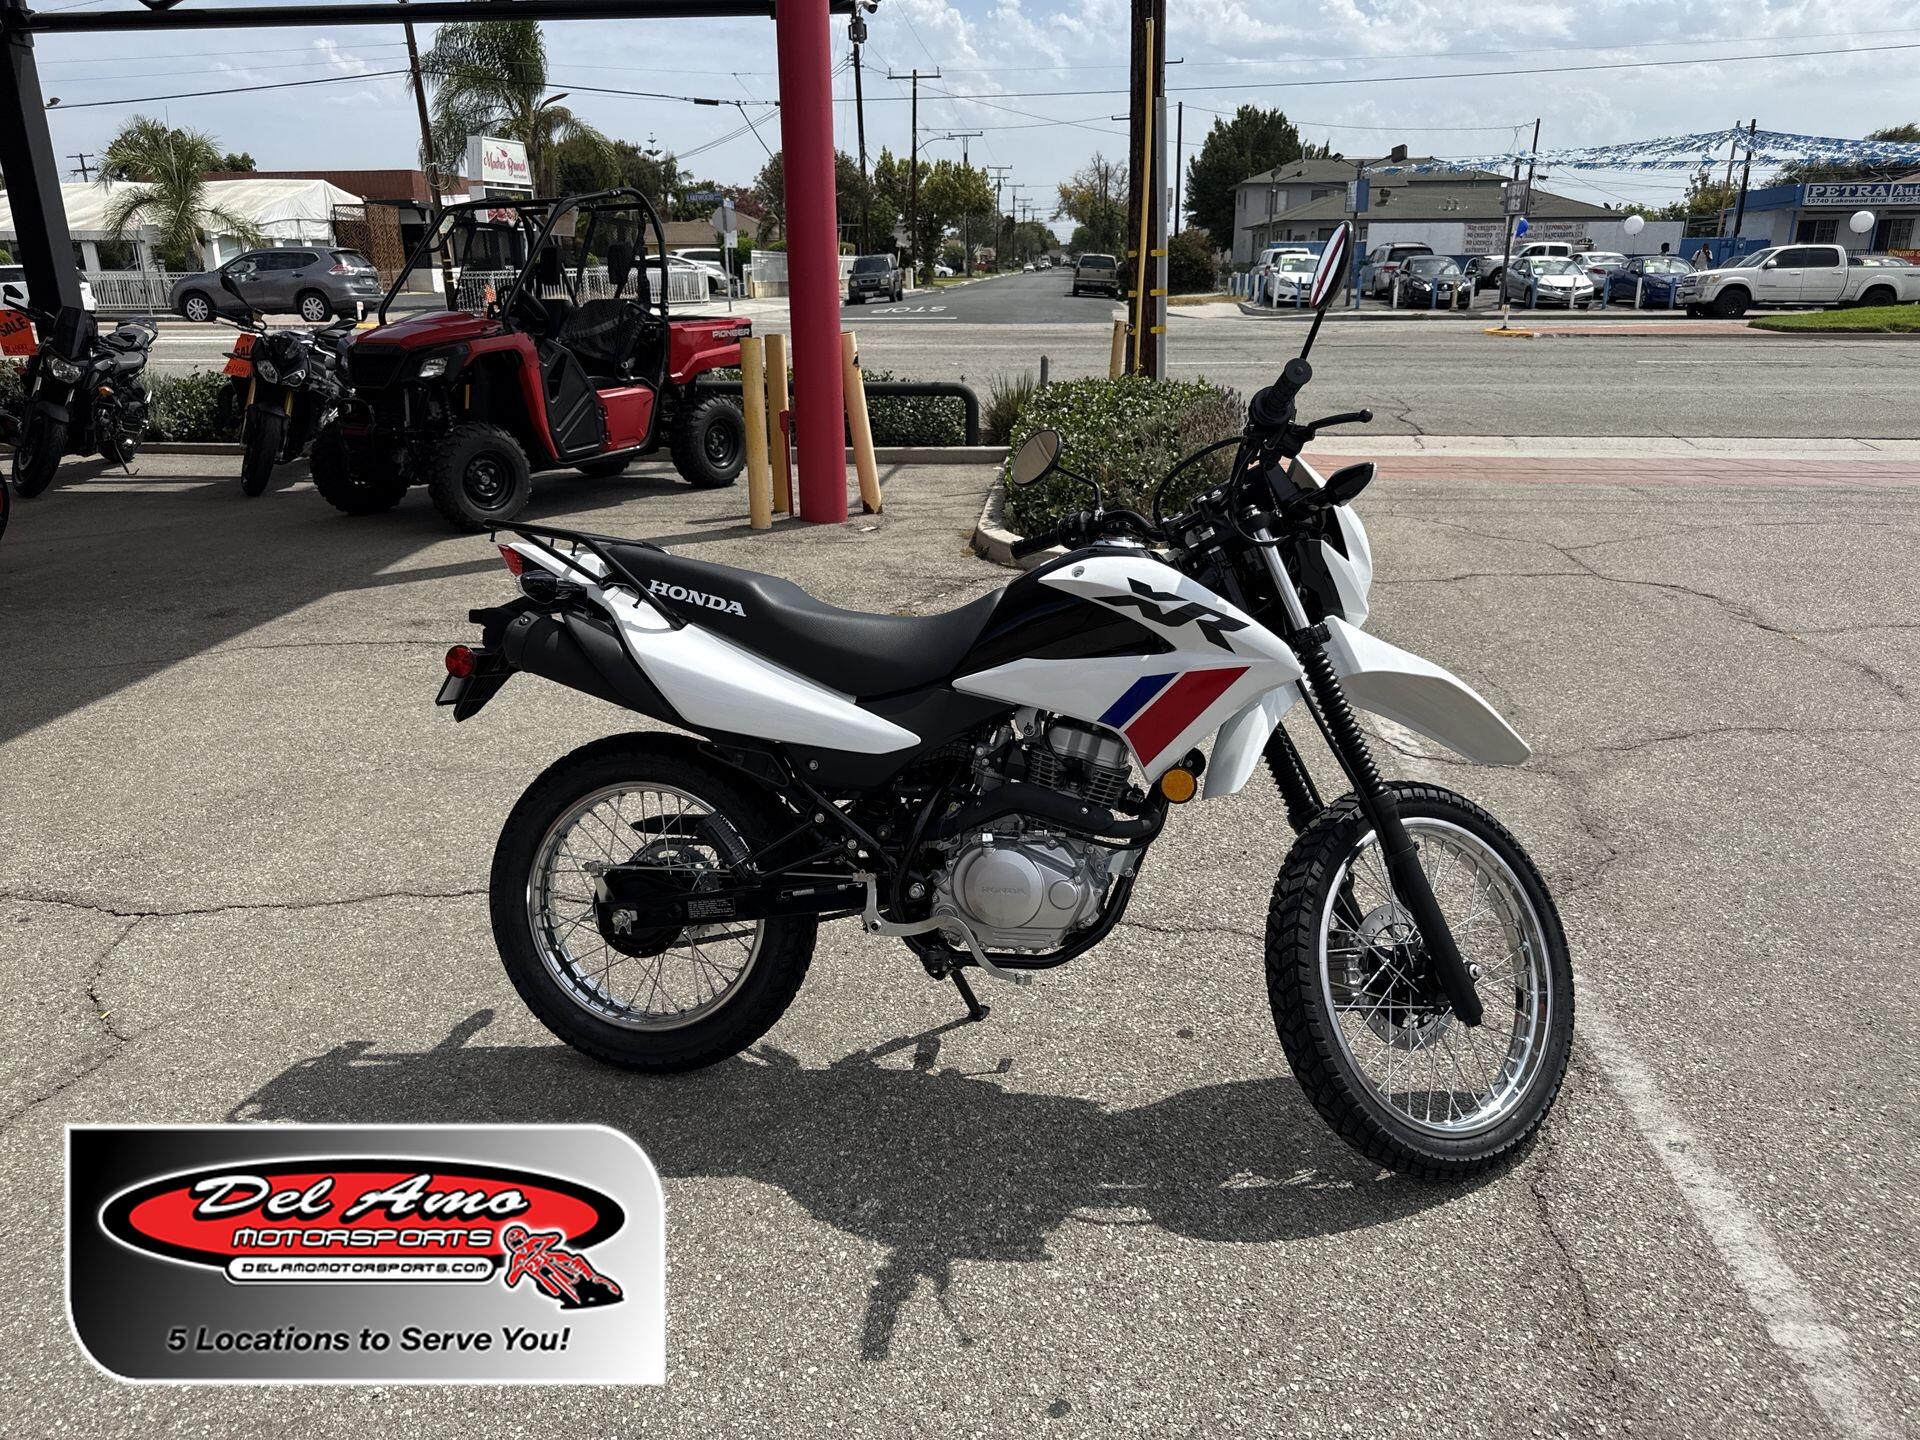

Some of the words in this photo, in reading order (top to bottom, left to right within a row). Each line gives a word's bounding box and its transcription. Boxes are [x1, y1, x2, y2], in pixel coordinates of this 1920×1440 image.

[1809, 185, 1887, 197] PETRA
[1888, 249, 1915, 257] MOVING
[871, 306, 947, 314] STOP
[0, 318, 29, 337] SALE
[712, 328, 750, 339] PIONEER
[648, 579, 747, 617] HONDA
[981, 886, 1026, 896] HONDA
